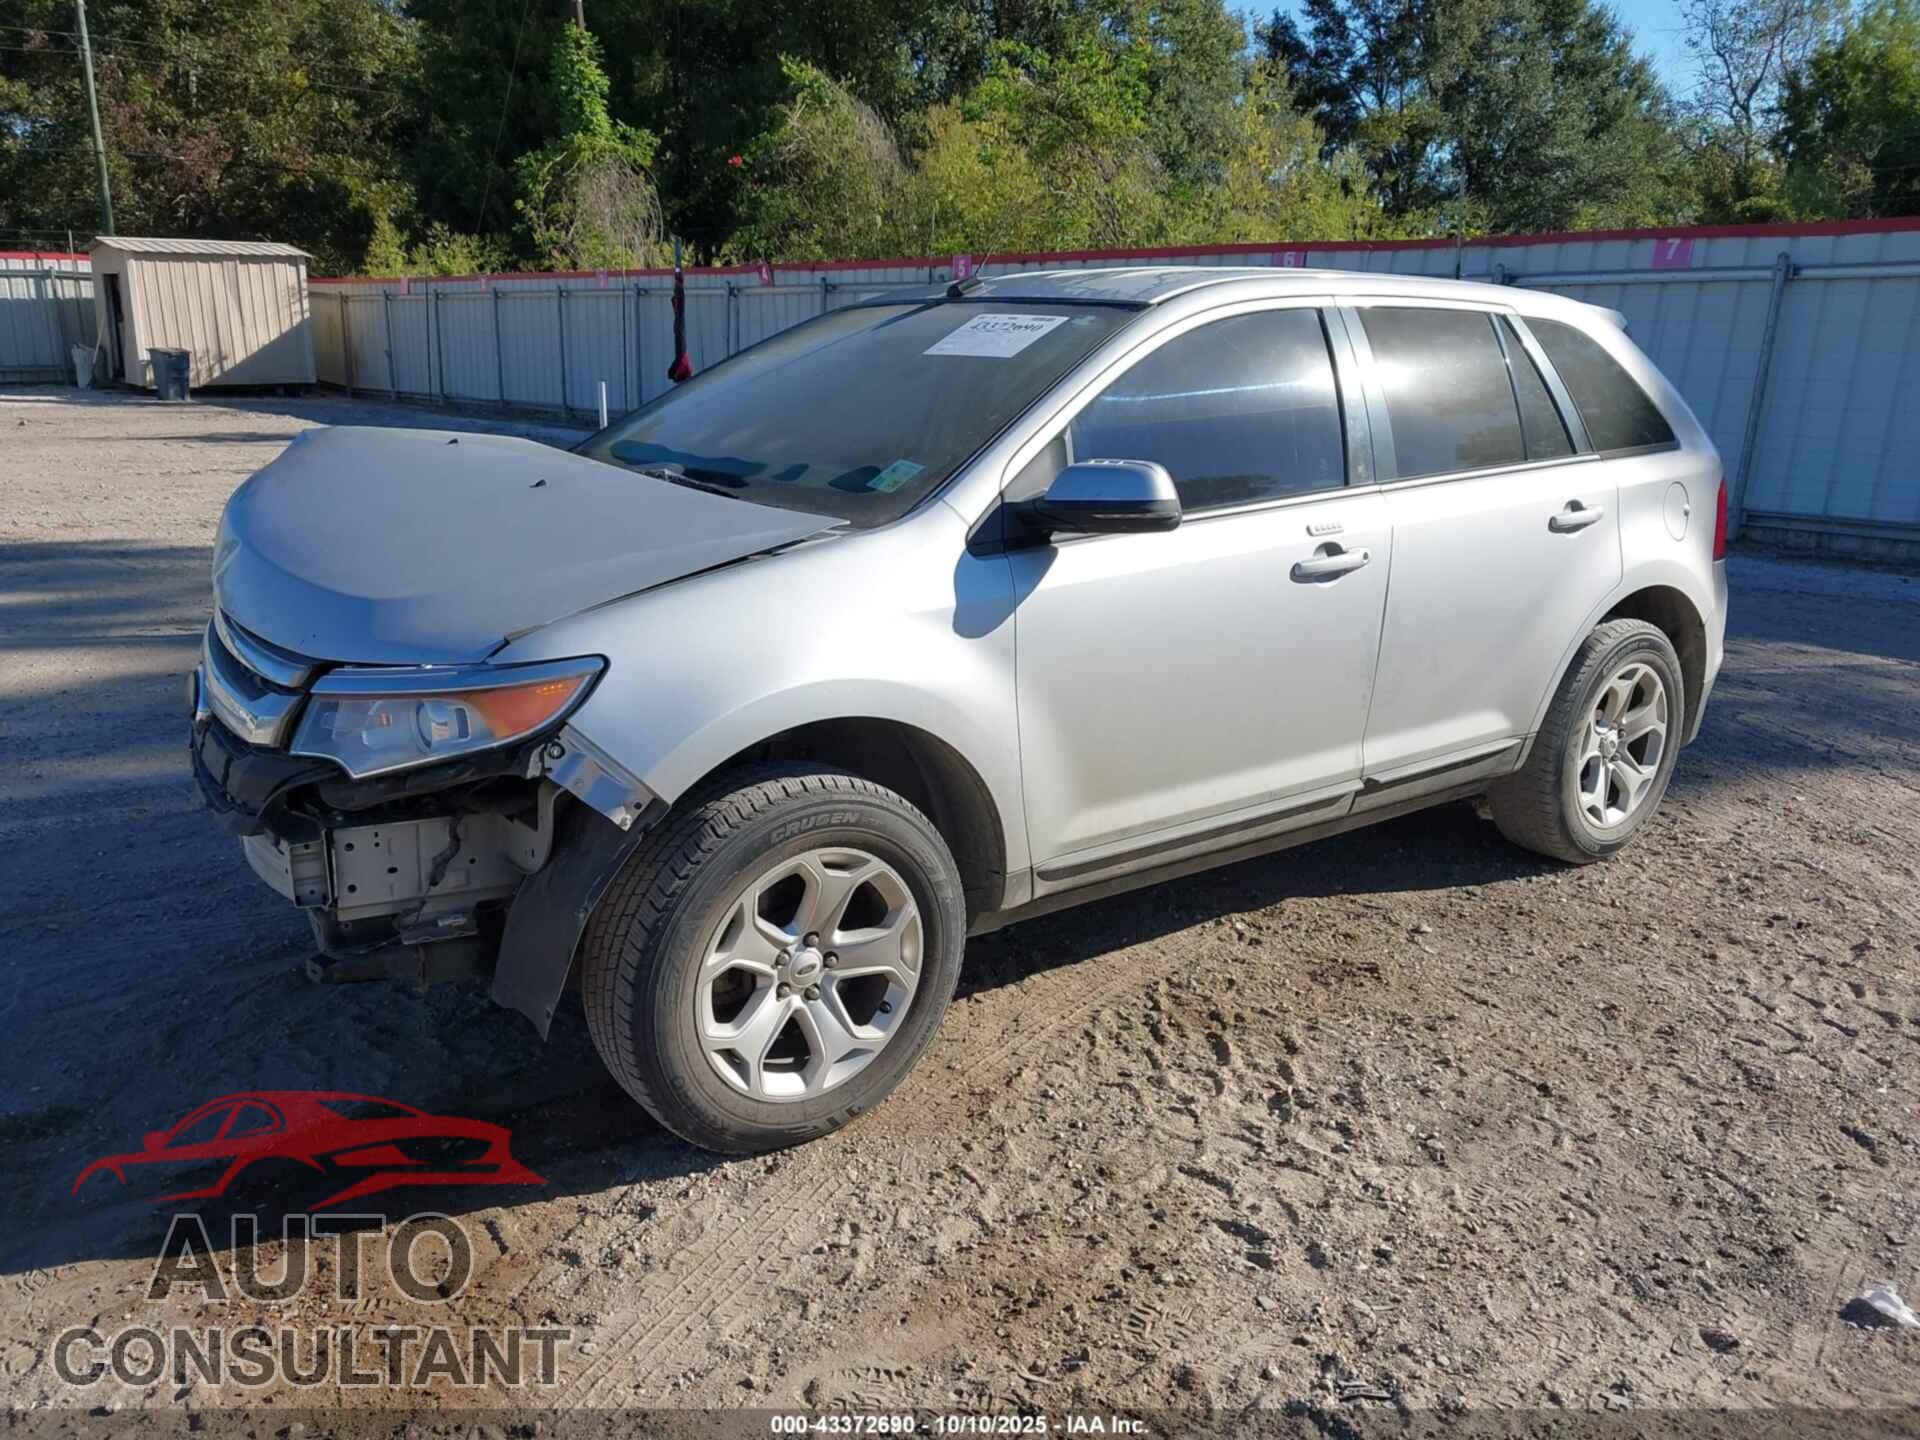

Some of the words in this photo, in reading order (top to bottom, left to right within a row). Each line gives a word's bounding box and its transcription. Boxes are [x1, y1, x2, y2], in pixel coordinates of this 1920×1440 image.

[1666, 238, 1681, 260] 7
[958, 259, 967, 276] 5
[1283, 251, 1297, 267] 6
[771, 811, 861, 844] CRUGEN
